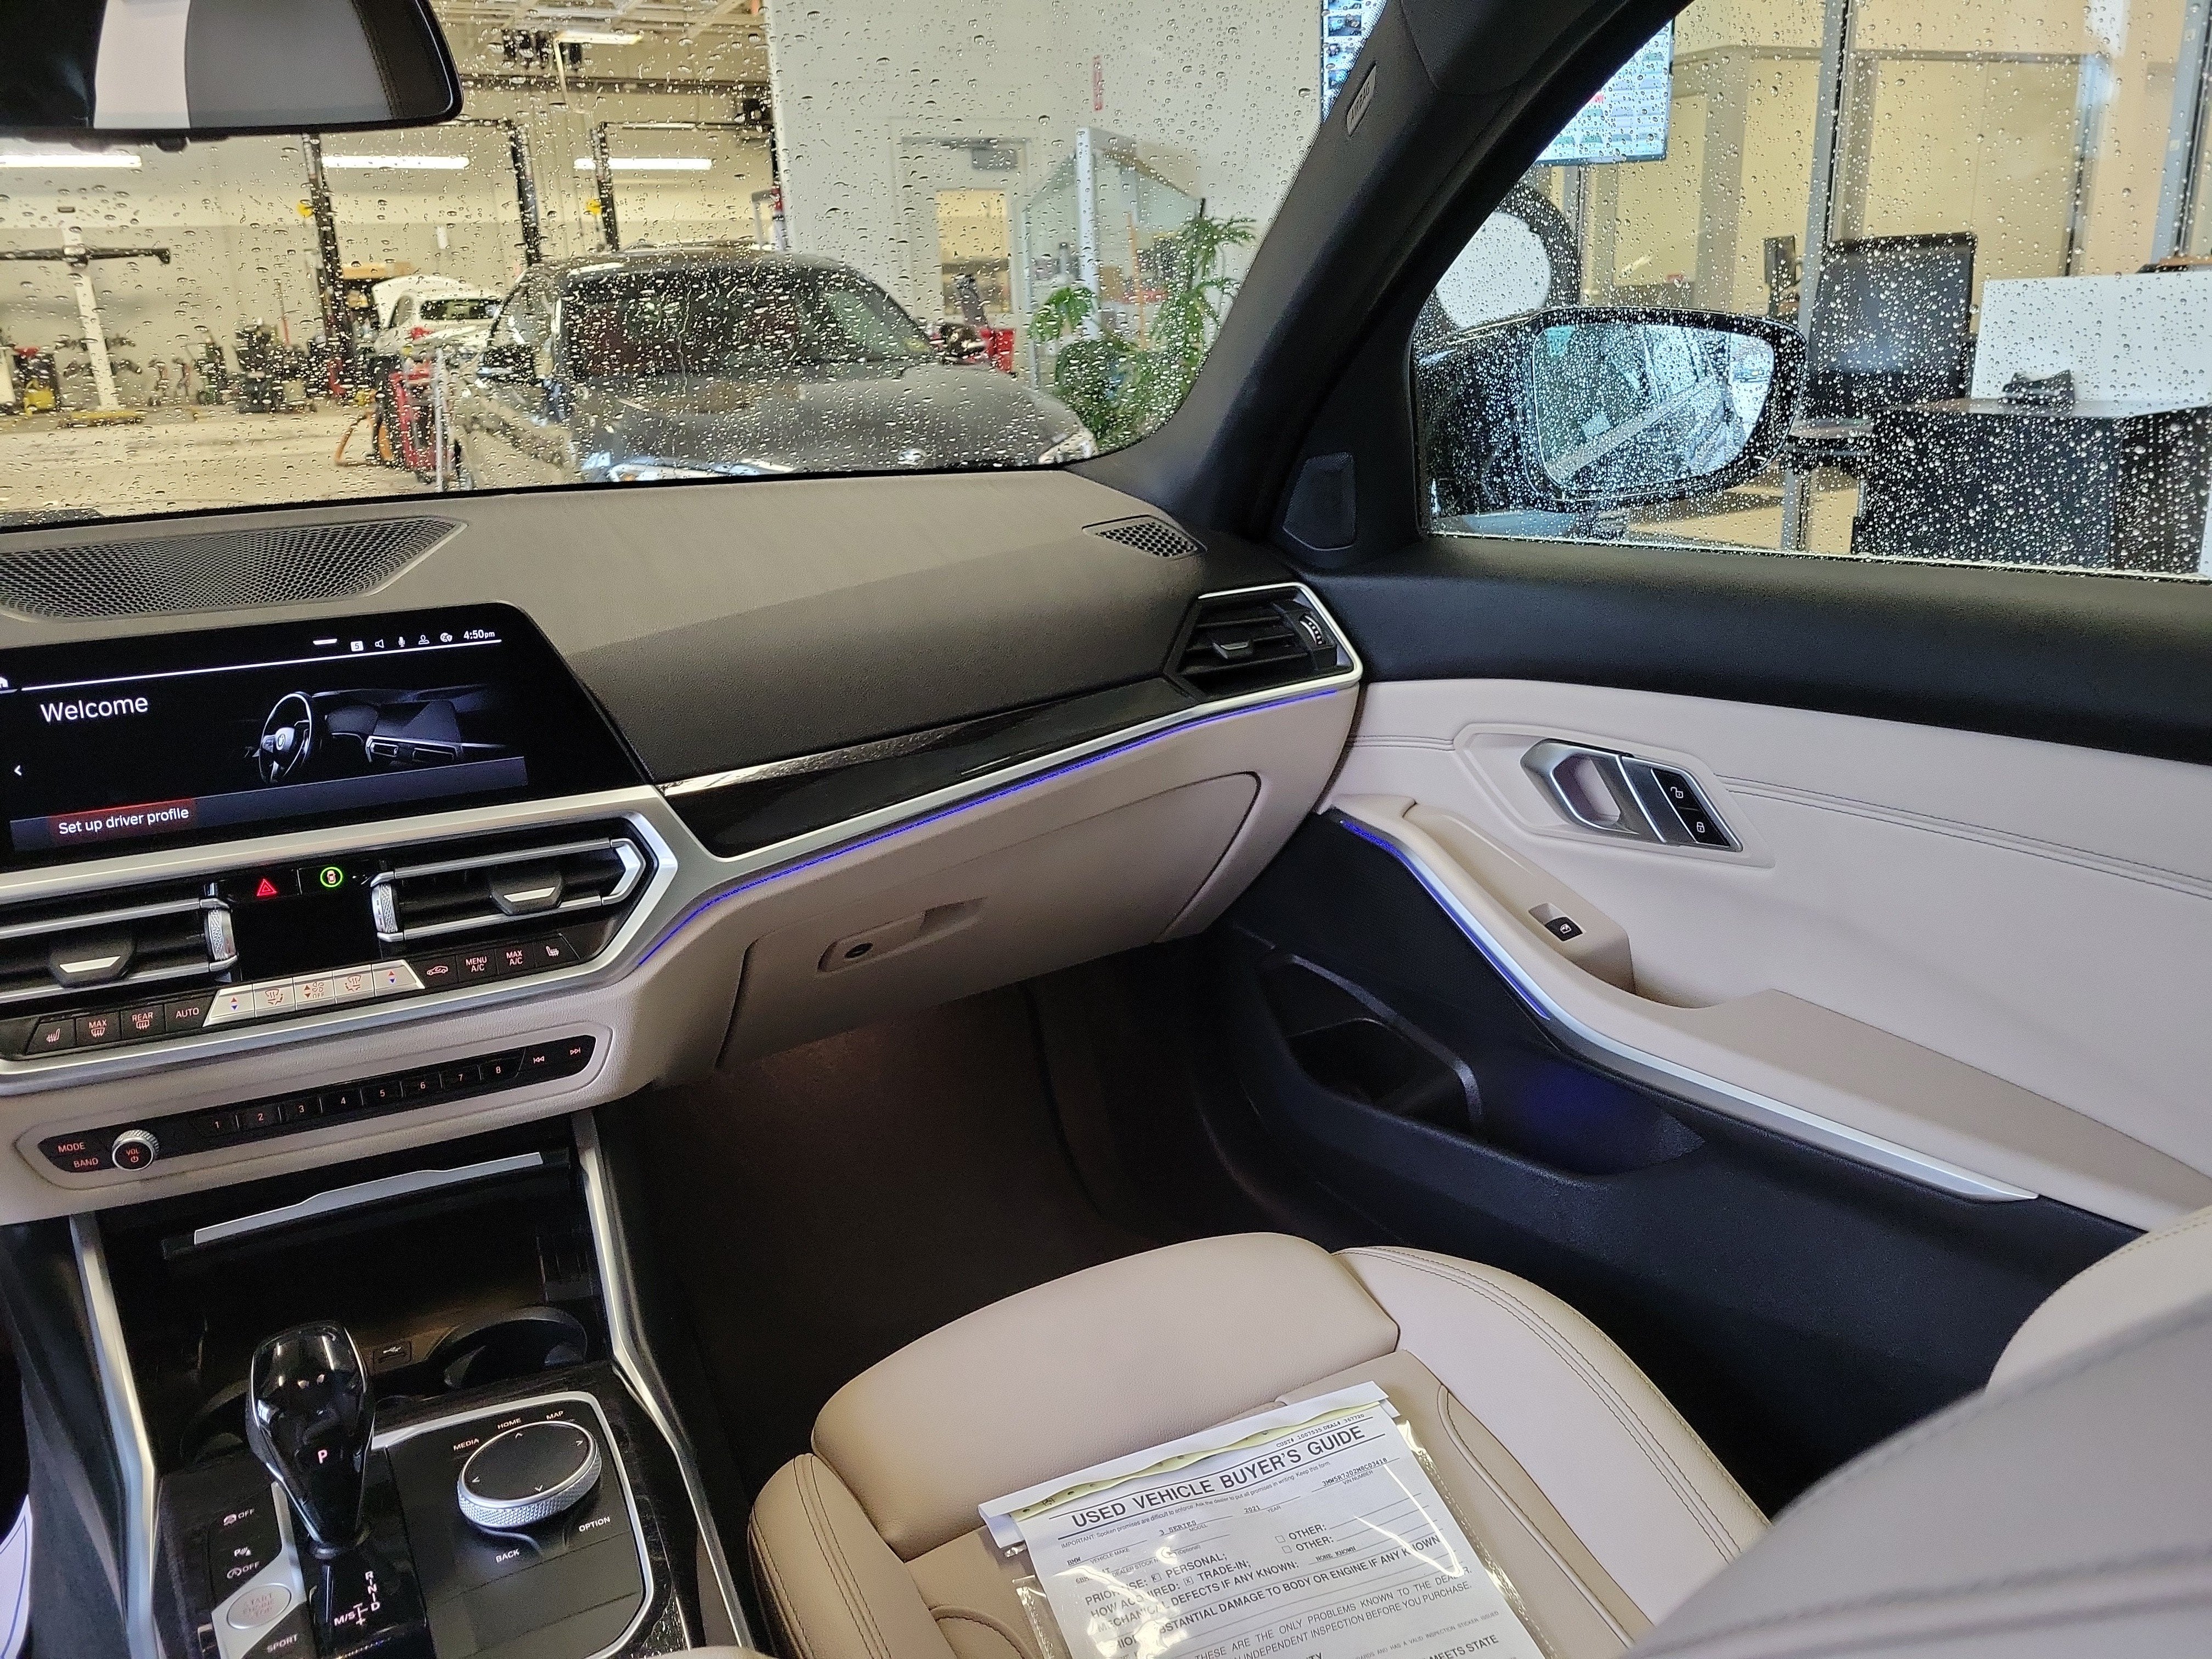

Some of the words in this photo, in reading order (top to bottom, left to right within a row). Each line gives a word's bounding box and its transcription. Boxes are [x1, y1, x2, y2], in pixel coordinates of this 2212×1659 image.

[464, 629, 495, 640] 4:50pm
[40, 696, 149, 723] Welcome
[59, 821, 82, 834] Set
[85, 819, 103, 833] up
[106, 814, 144, 829] driver
[147, 807, 189, 825] profile
[506, 950, 523, 959] MAX
[465, 956, 488, 967] MENU
[509, 957, 523, 966] A/C
[471, 964, 485, 973] A/C
[132, 1012, 153, 1022] REAR
[175, 1007, 200, 1019] AUTO
[88, 1019, 107, 1029] MAX
[420, 1081, 426, 1090] 6
[298, 1105, 304, 1113] 3
[258, 1113, 264, 1121] 2
[58, 1142, 86, 1153] MODE
[126, 1148, 140, 1156] VOL
[74, 1157, 99, 1169] BAND
[546, 1410, 564, 1420] MAP
[497, 1417, 522, 1430] HOME
[453, 1438, 480, 1452] MEDIA
[317, 1449, 328, 1464] P
[1071, 1502, 1126, 1528] USED
[1132, 1480, 1216, 1509] VEHICLE
[1219, 1449, 1302, 1489] BUYER'S
[1307, 1426, 1366, 1456] GUIDE
[1342, 1477, 1352, 1485] VIN
[1352, 1470, 1374, 1482] NUMBER
[1096, 1527, 1117, 1540] Spoken
[1117, 1520, 1141, 1536] promises
[1141, 1518, 1150, 1526] are
[1150, 1510, 1169, 1522] difficult
[1213, 1496, 1229, 1504] dealer
[1235, 1492, 1244, 1502] put
[1250, 1483, 1273, 1497] promises
[1295, 1469, 1310, 1480] Keep
[1309, 1464, 1319, 1472] this
[238, 1508, 255, 1520] OFF
[1244, 1505, 1261, 1514] 2021
[1266, 1505, 1282, 1514] YEAR
[578, 1516, 611, 1532] OPTION
[1168, 1520, 1197, 1533] SERIES
[1188, 1523, 1208, 1532] MODEL
[1288, 1523, 1327, 1541] OTHER:
[1177, 1544, 1201, 1557] (Optional)
[1295, 1536, 1334, 1552] OTHER:
[495, 1548, 520, 1564] BACK
[1066, 1556, 1081, 1566] BMW
[1090, 1551, 1119, 1564] VEHICLE
[1119, 1547, 1130, 1556] MAKE
[242, 1561, 260, 1573] OFF
[1112, 1566, 1134, 1577] DEALER
[1135, 1560, 1153, 1570] STOCK
[1126, 1578, 1148, 1591] SE:
[1165, 1553, 1228, 1578] PERSONAL;
[365, 1570, 374, 1581] R
[1171, 1582, 1221, 1606] DEFECTS
[1222, 1578, 1231, 1589] IF
[1234, 1571, 1255, 1586] ANY
[1256, 1560, 1299, 1578] KNOWN:
[1335, 1545, 1357, 1557] KNOWN
[1218, 1590, 1266, 1613] DAMAGE
[1265, 1585, 1281, 1597] TO
[1282, 1577, 1312, 1592] BODY
[1313, 1573, 1329, 1583] OR
[1331, 1562, 1369, 1579] ENGINE
[1370, 1558, 1378, 1568] IF
[1380, 1550, 1400, 1565] ANY
[367, 1584, 377, 1594] N
[1091, 1601, 1117, 1618] HOW
[1198, 1559, 1251, 1582] TRADE-IN;
[370, 1602, 381, 1612] D
[334, 1611, 356, 1627] M/S
[1232, 1638, 1251, 1652] ARE
[1255, 1629, 1275, 1643] THE
[1279, 1618, 1303, 1634] ONLY
[1307, 1602, 1357, 1624] PROBLEMS
[1359, 1592, 1394, 1608] KNOWN
[1397, 1587, 1410, 1598] TO
[1413, 1581, 1432, 1593] THE
[1243, 1631, 1308, 1659] INDEPENDENT
[1311, 1613, 1365, 1639] INSPECTION
[1365, 1602, 1402, 1621] BEFORE
[1402, 1596, 1422, 1609] YOU
[1423, 1581, 1472, 1603] PURCHASE.
[1408, 1635, 1424, 1644] VALID
[1426, 1625, 1456, 1639] INSPECTION
[1457, 1617, 1479, 1629] STICKER
[1480, 1610, 1499, 1621] ISSUED
[267, 1633, 298, 1653] SPORT
[1429, 1646, 1466, 1659] MEETS
[1465, 1634, 1499, 1652] STATE
